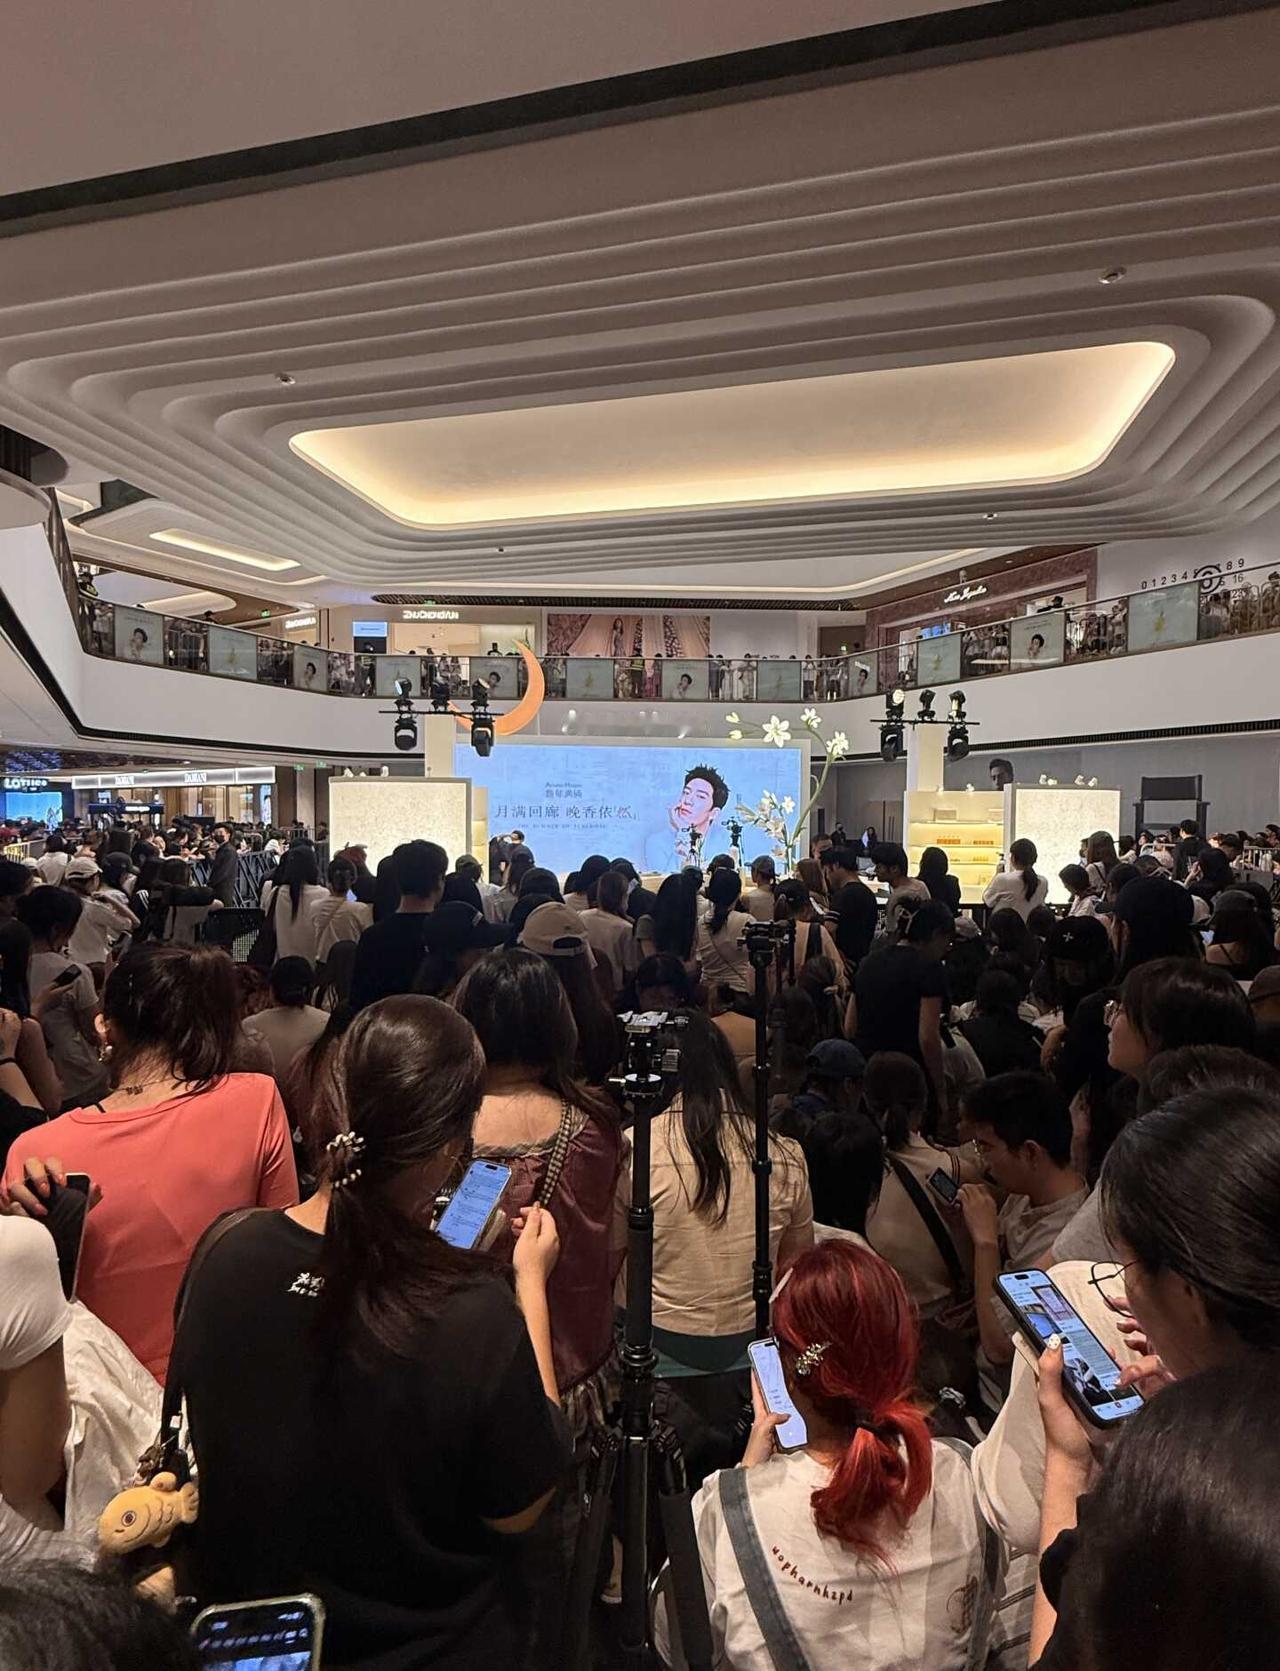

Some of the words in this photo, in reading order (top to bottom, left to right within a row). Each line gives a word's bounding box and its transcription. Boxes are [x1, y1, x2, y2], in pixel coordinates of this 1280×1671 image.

[1161, 577, 1167, 585] 2
[1171, 574, 1177, 583] 3
[1181, 571, 1188, 580] 4
[1226, 561, 1233, 570] 8
[1238, 558, 1244, 568] 9
[495, 804, 560, 819] 月满回廊
